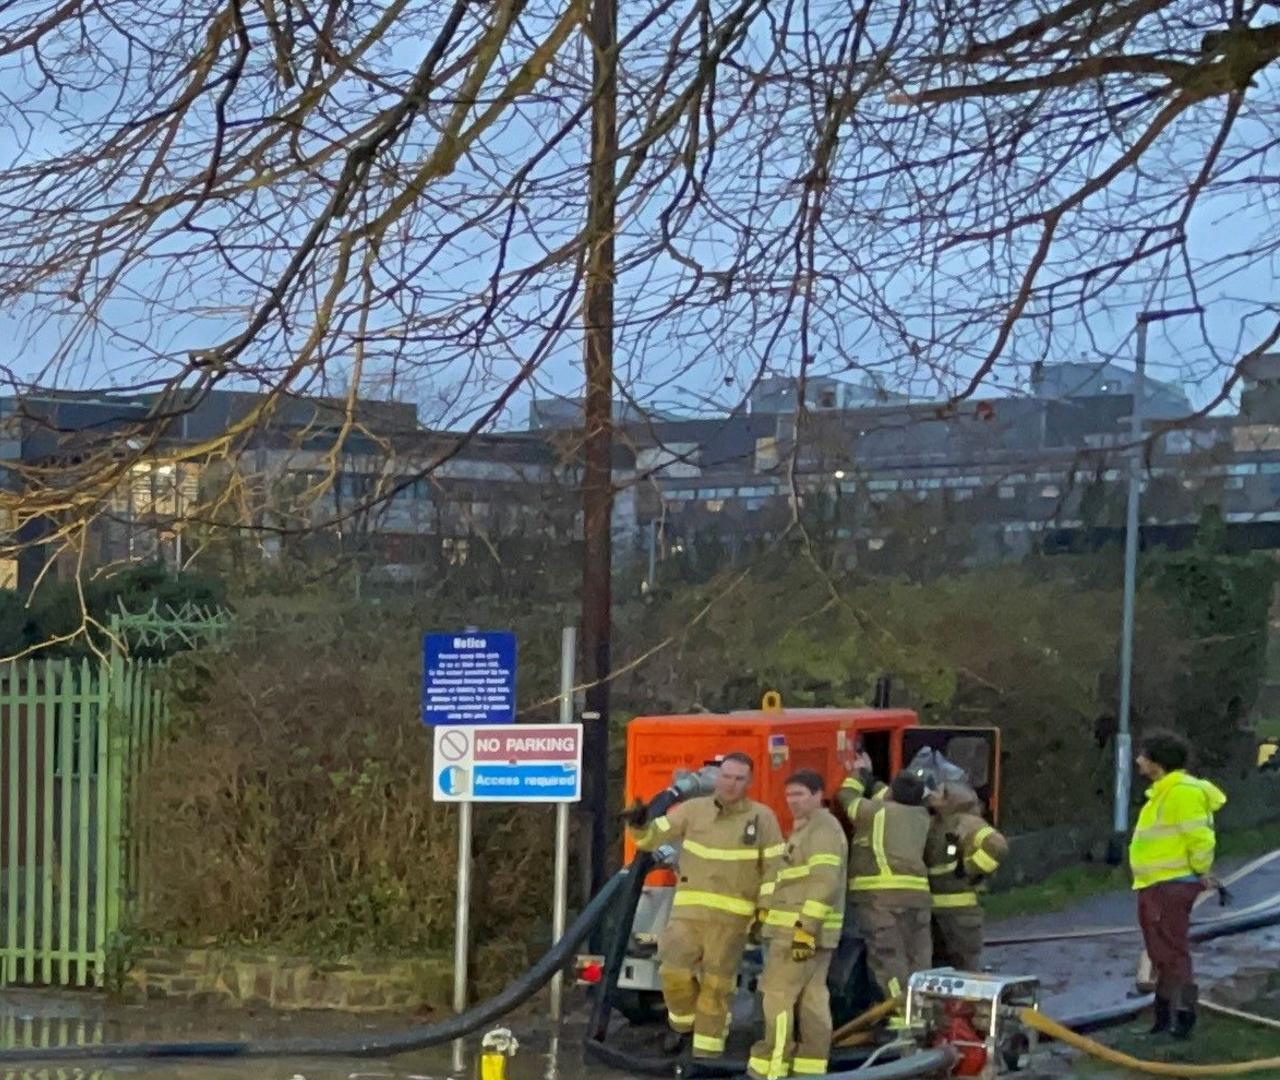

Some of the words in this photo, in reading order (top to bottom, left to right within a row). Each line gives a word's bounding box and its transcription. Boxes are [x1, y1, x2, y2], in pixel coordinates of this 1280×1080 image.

[453, 637, 487, 650] Notice
[476, 739, 501, 752] NO
[505, 737, 575, 752] PARKING
[475, 774, 520, 786] Access
[524, 774, 576, 788] required
